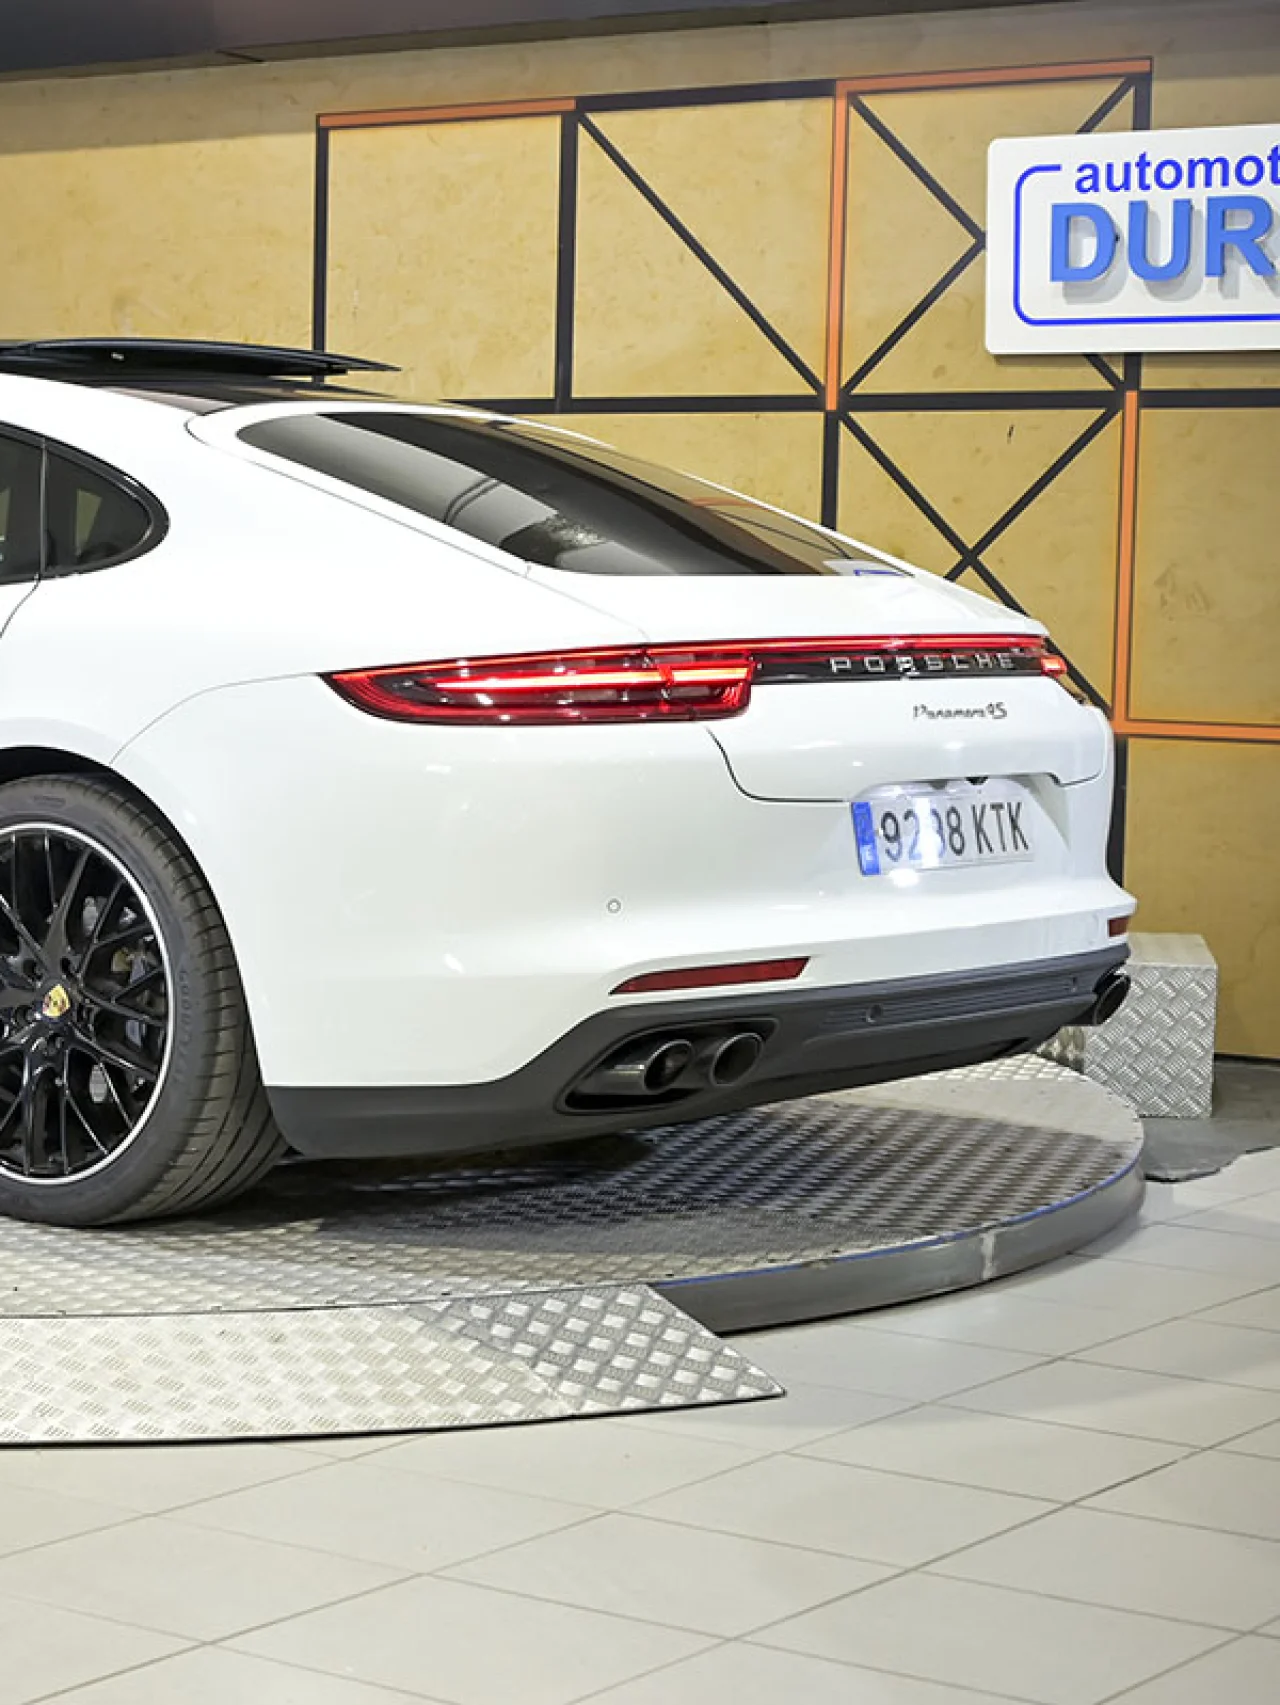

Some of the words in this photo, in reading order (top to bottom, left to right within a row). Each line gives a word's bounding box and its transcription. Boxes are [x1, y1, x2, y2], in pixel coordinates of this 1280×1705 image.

[1050, 195, 1276, 282] DUR
[829, 653, 1014, 674] PORSCHE
[972, 802, 1029, 854] KTK
